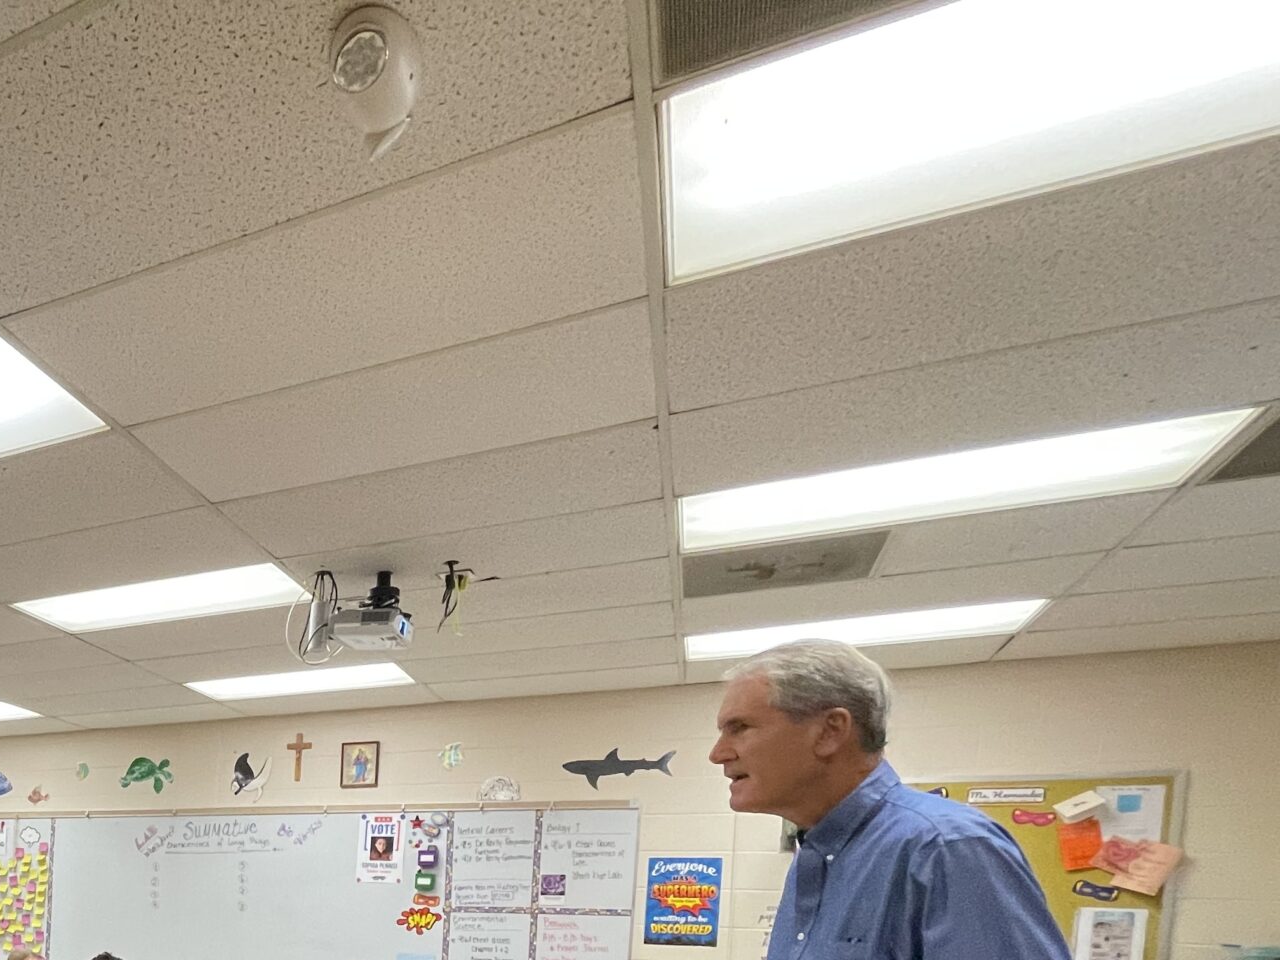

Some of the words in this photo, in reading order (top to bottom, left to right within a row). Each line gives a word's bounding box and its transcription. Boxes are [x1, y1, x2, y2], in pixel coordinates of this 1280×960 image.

[370, 824, 396, 834] VOTE
[651, 861, 718, 876] Everyone
[652, 884, 717, 898] SUPERHERO
[650, 924, 712, 935] DISCOVERED
